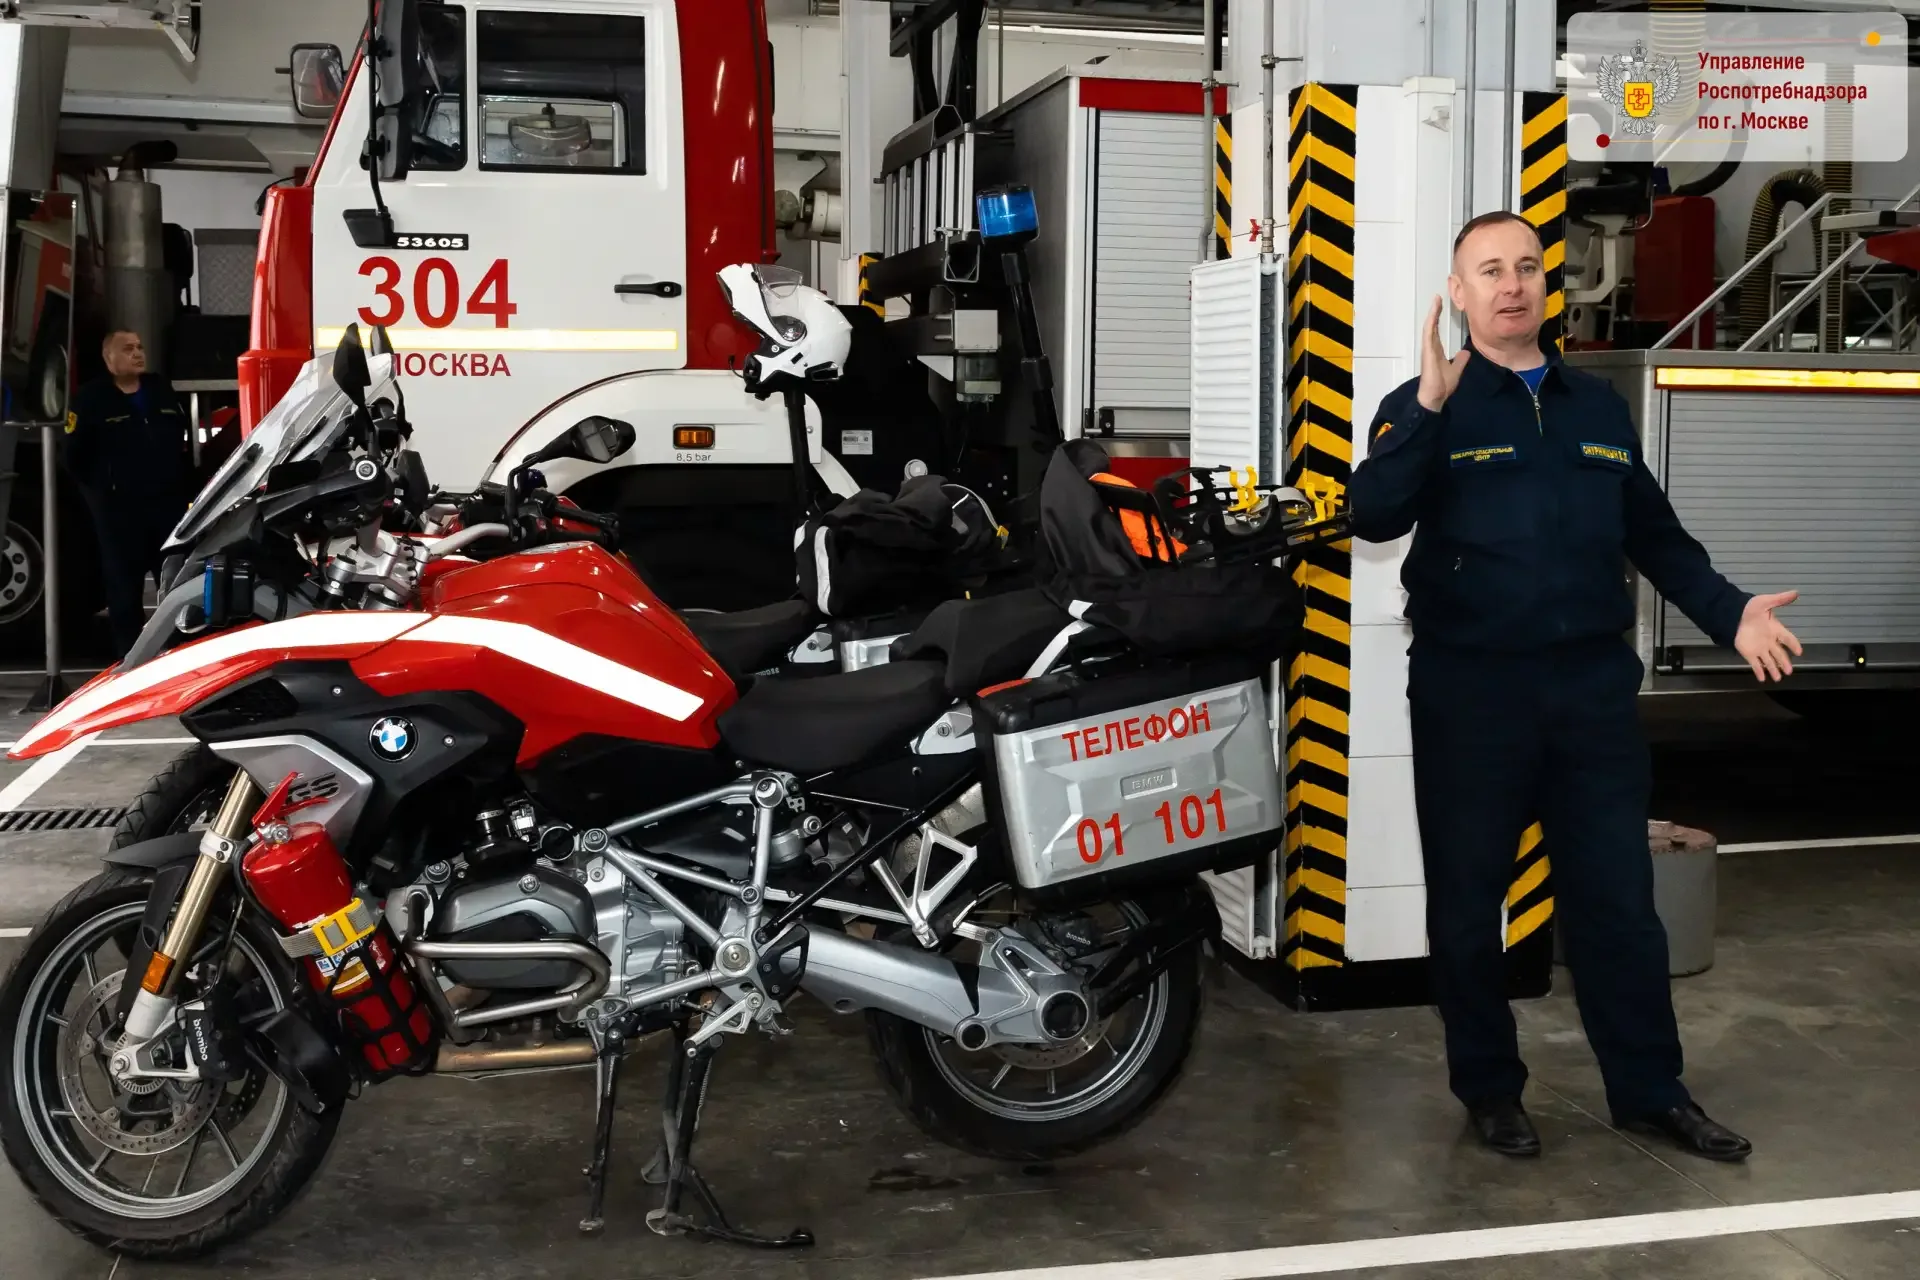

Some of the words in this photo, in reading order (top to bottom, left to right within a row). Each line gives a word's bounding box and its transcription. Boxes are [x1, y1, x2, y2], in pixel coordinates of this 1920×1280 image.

[396, 236, 464, 248] 53605
[357, 256, 518, 329] 304
[695, 452, 712, 462] bar
[1062, 702, 1211, 762] ТЕЛЕФОН
[1131, 774, 1165, 790] BMW
[1076, 812, 1124, 864] 01
[1154, 788, 1227, 844] 101
[1065, 931, 1091, 945] brembo
[192, 1018, 208, 1061] brembo
